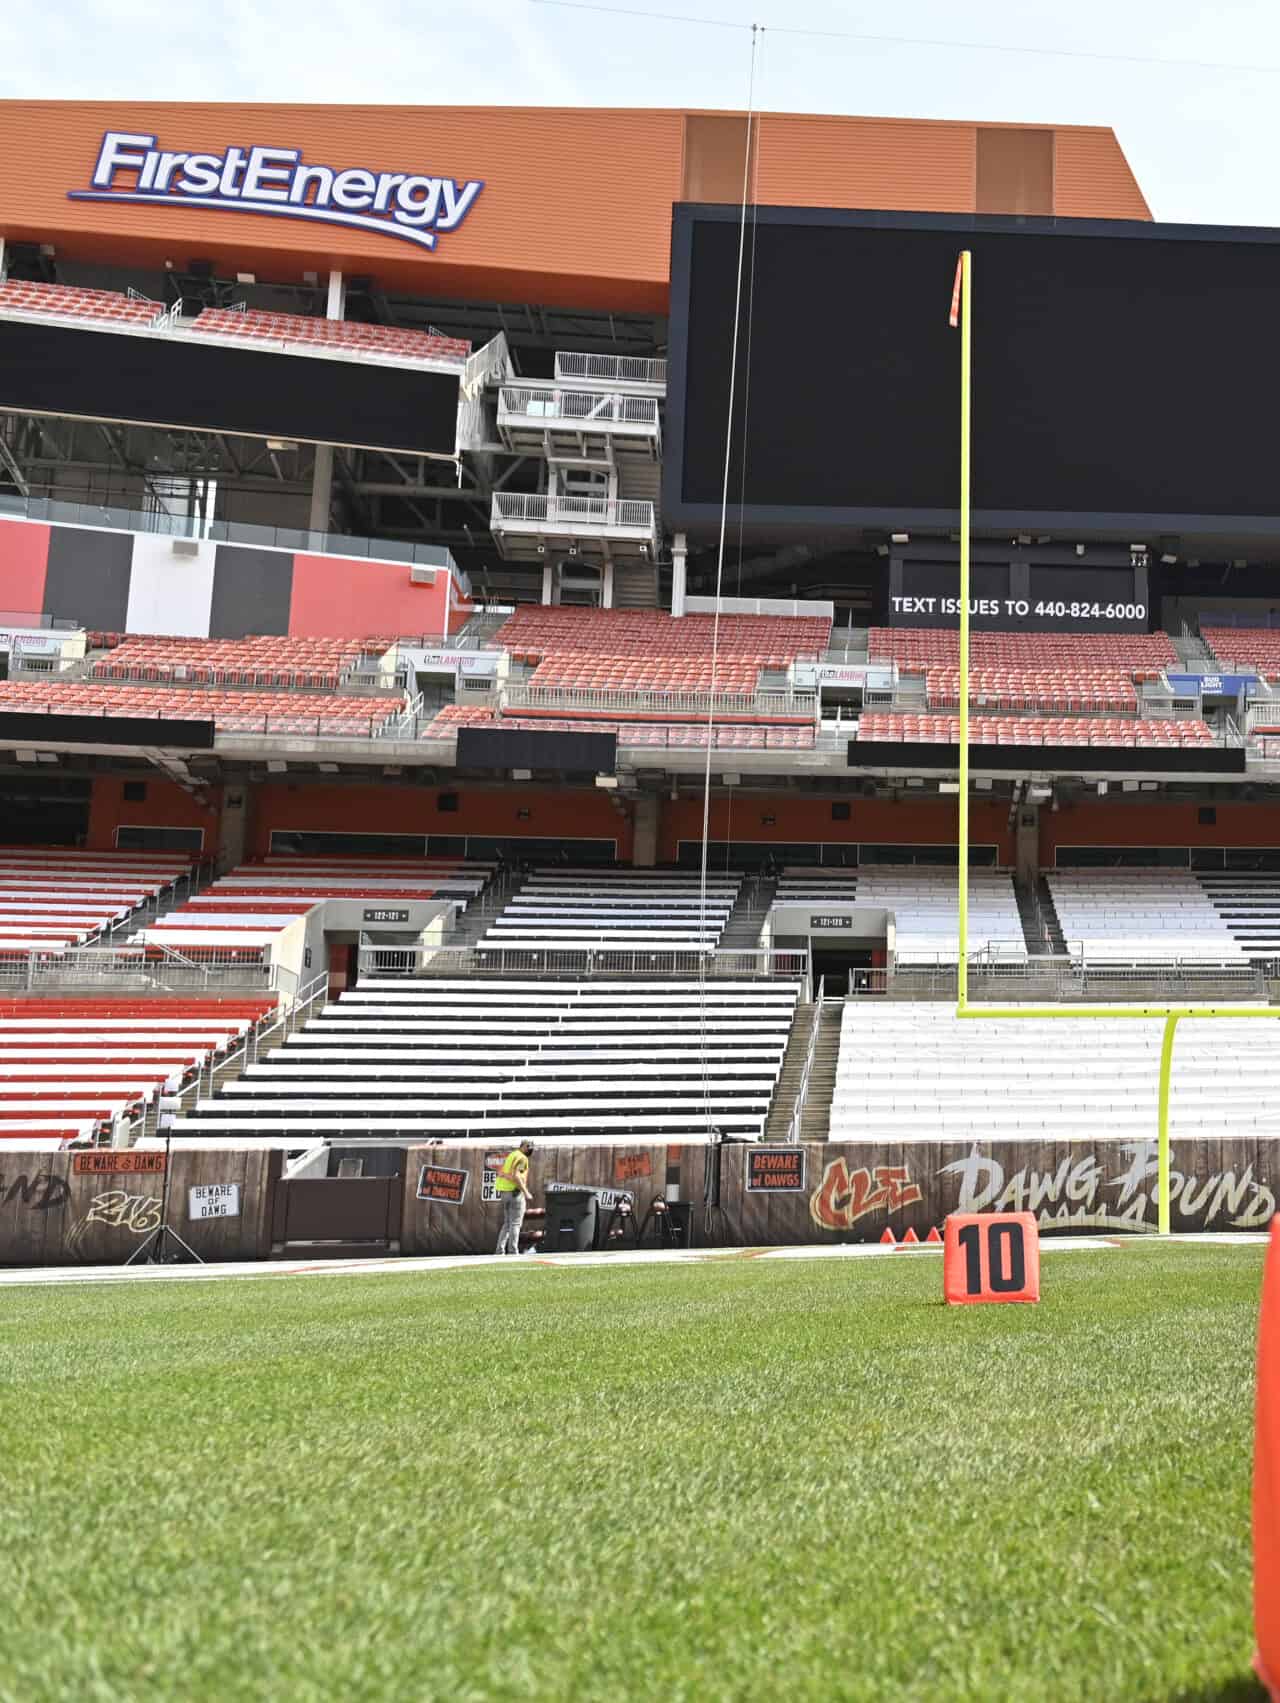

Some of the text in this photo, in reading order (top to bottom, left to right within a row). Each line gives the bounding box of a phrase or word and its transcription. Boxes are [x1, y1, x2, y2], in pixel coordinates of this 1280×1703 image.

[91, 131, 485, 233] FirstEnergy
[892, 597, 936, 613] TEXT
[1004, 600, 1029, 616] TO
[1034, 601, 1146, 619] 440-824-6000
[80, 1157, 119, 1171] BEWARE
[134, 1155, 162, 1170] DAWG
[754, 1155, 799, 1169] BEWARE
[764, 1173, 799, 1187] DAWGS
[934, 1140, 1277, 1227] DAWG POUND
[195, 1186, 232, 1198] BEWARE
[810, 1157, 923, 1230] CLE
[201, 1204, 227, 1217] DAWG
[959, 1222, 1026, 1294] 10
